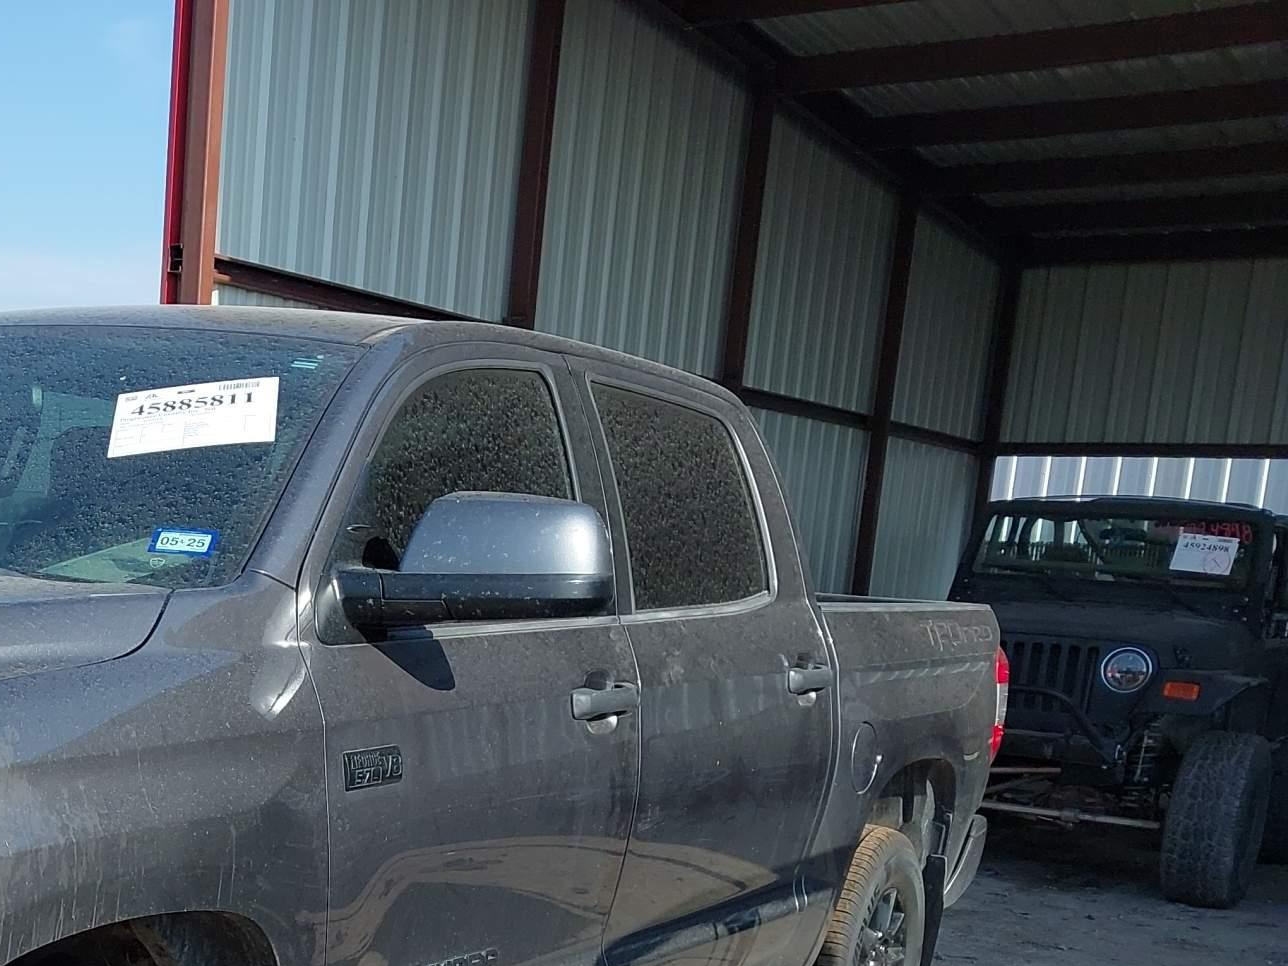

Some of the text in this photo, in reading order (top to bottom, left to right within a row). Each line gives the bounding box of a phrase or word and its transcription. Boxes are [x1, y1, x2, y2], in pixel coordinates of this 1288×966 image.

[130, 391, 253, 416] 45885811
[160, 536, 207, 548] 05 25
